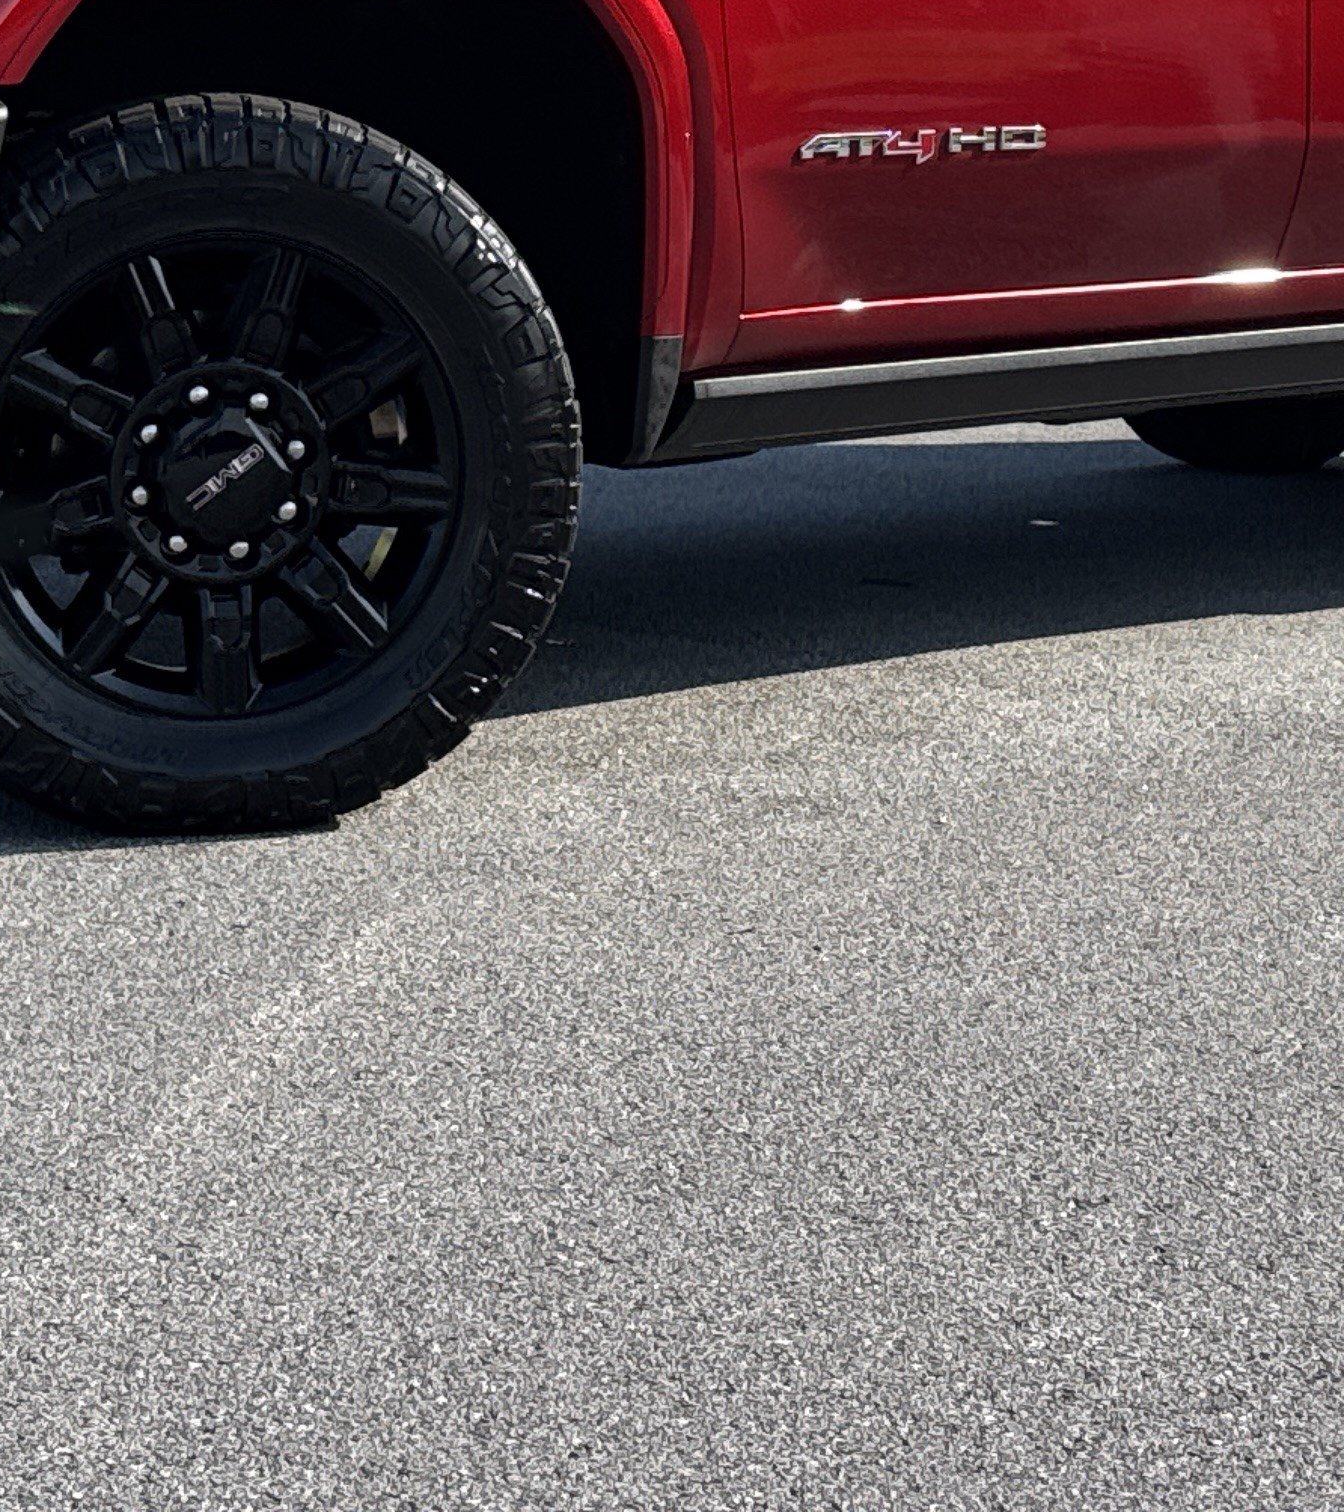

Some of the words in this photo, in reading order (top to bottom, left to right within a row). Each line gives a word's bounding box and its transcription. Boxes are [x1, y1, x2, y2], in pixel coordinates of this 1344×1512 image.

[799, 128, 937, 165] AT4
[948, 121, 1048, 153] HD
[185, 443, 265, 512] GMC
